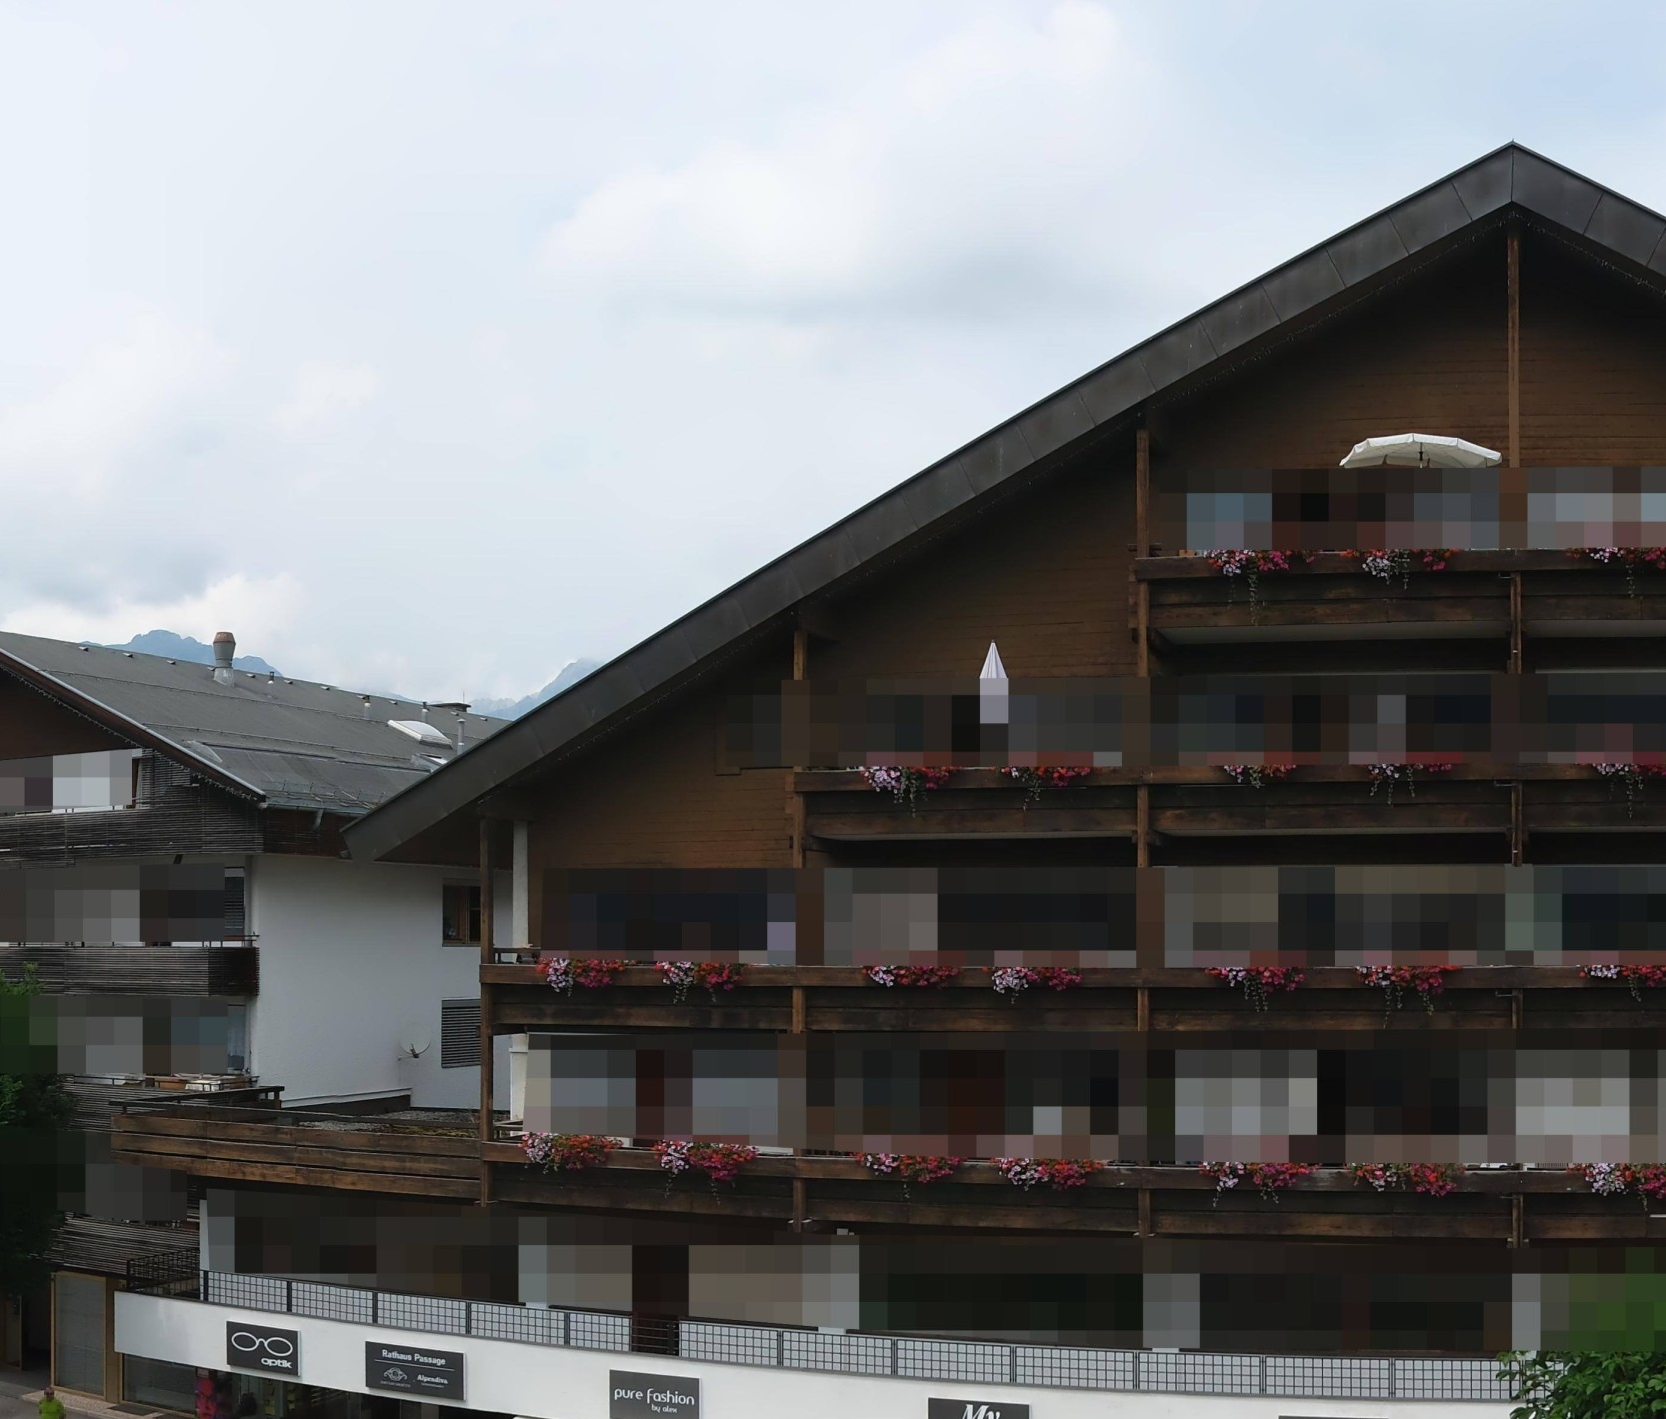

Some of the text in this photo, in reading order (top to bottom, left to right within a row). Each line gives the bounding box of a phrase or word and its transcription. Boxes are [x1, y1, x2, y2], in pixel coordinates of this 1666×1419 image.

[261, 1357, 292, 1369] optik
[382, 1349, 446, 1366] Rathaus Passage
[614, 1388, 695, 1406] pure fashion
[651, 1404, 678, 1413] by alex
